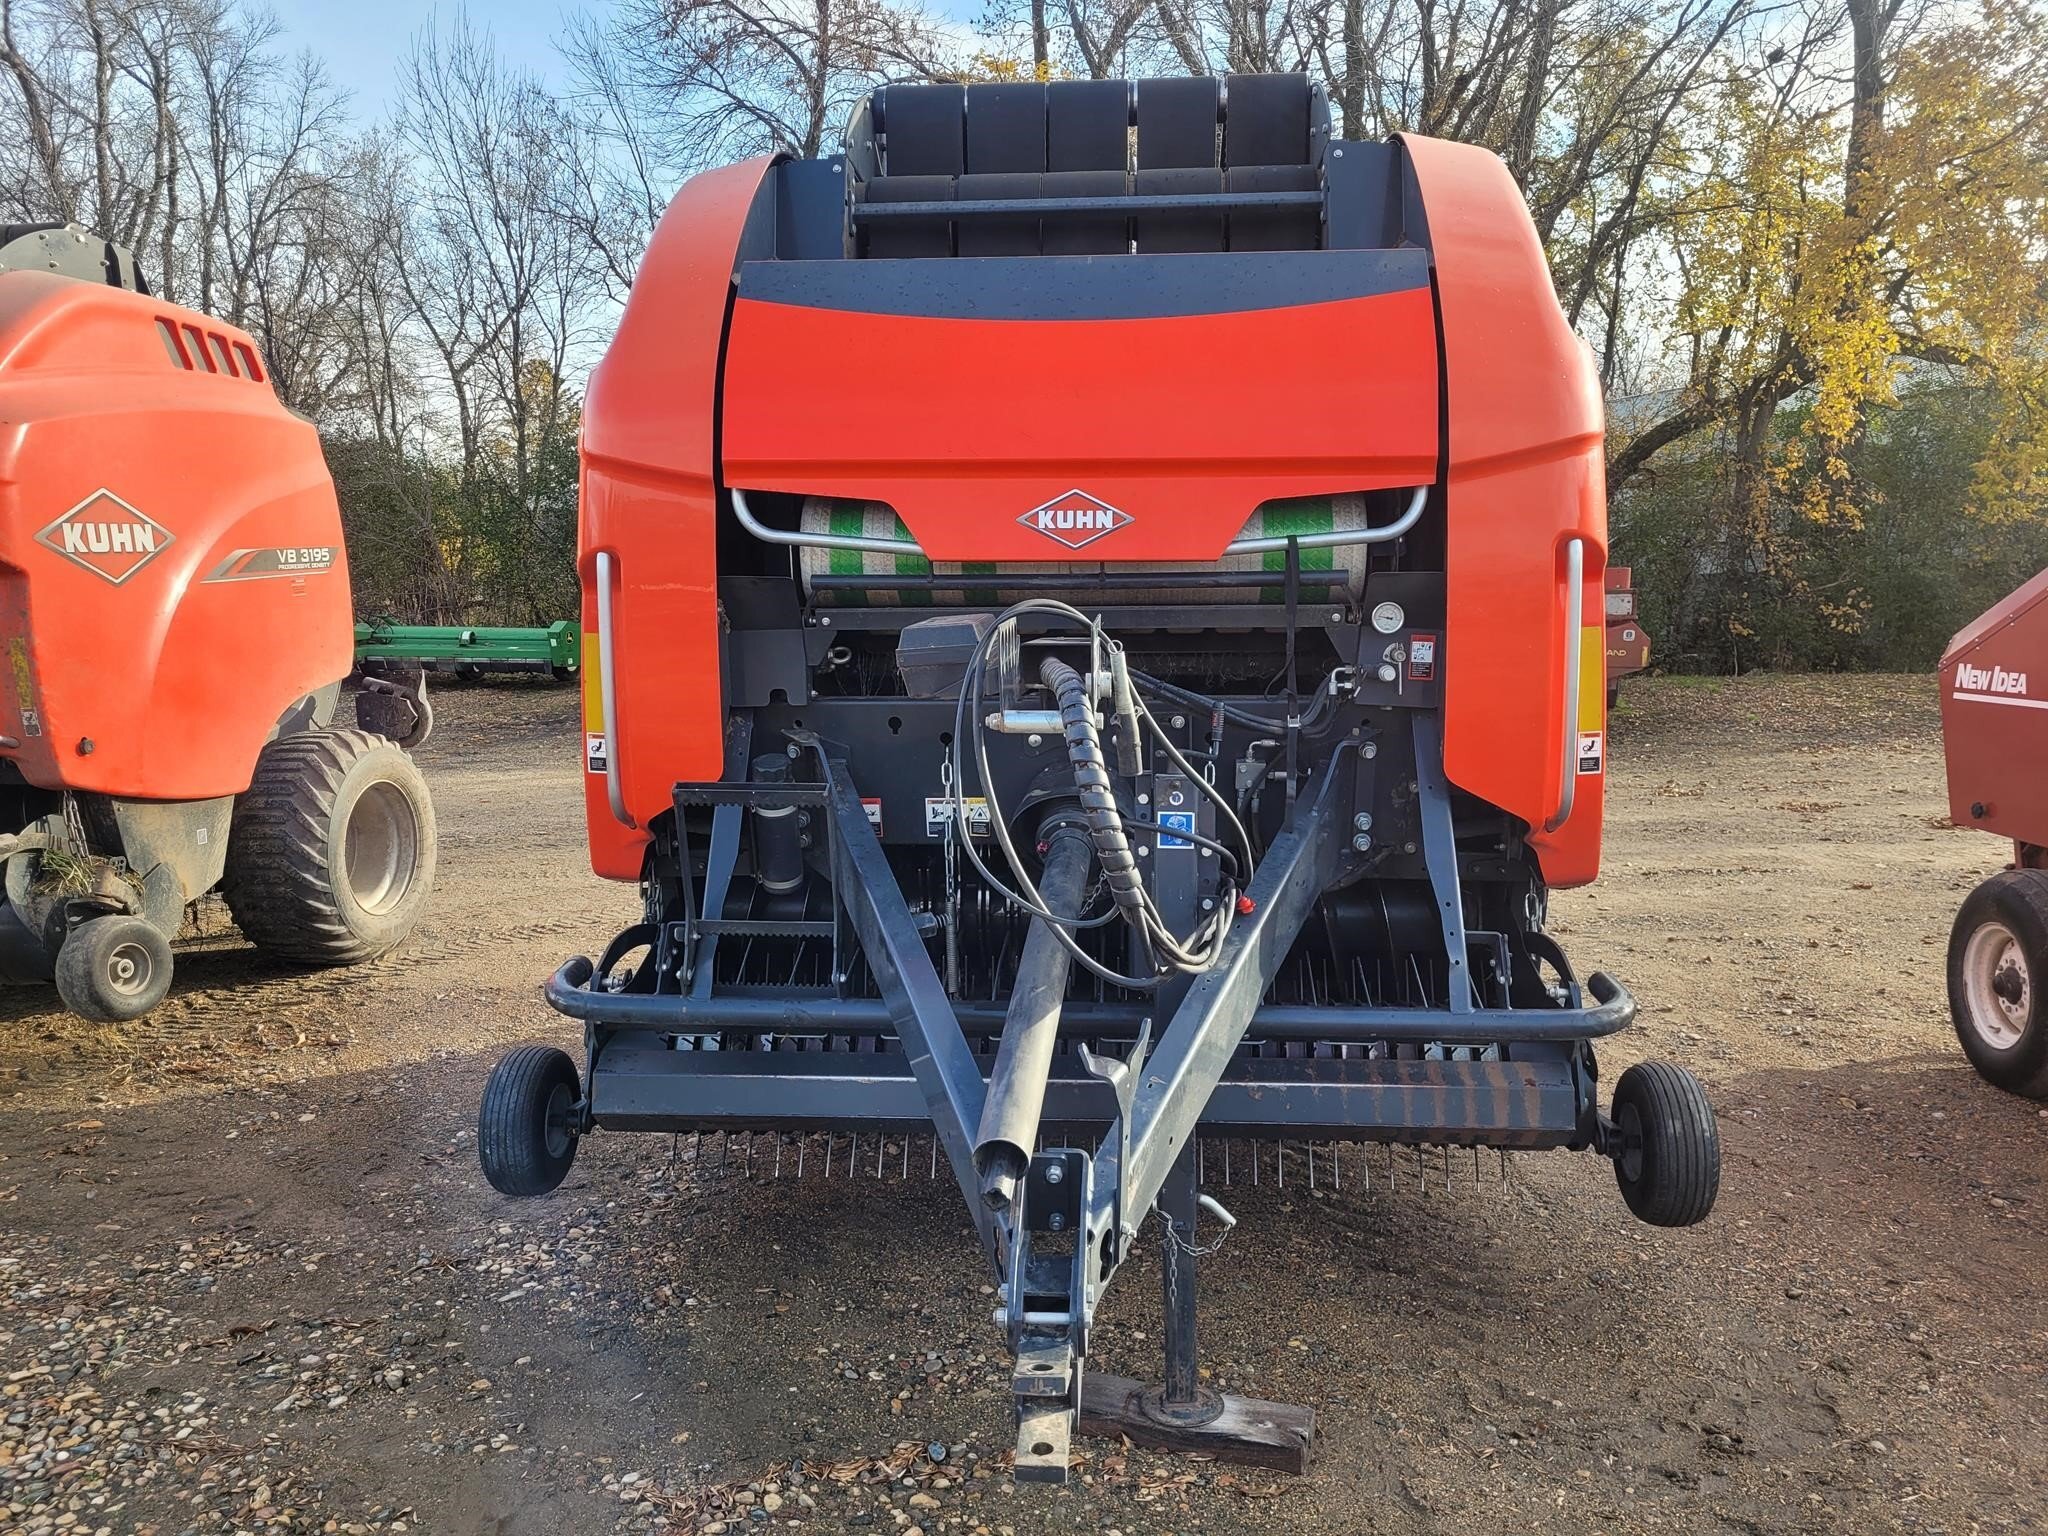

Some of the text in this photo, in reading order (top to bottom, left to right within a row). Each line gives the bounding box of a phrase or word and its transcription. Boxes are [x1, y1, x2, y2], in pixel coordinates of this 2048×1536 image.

[1038, 510, 1113, 529] KUHN
[62, 522, 155, 553] KUHN
[276, 547, 330, 563] VB 3195
